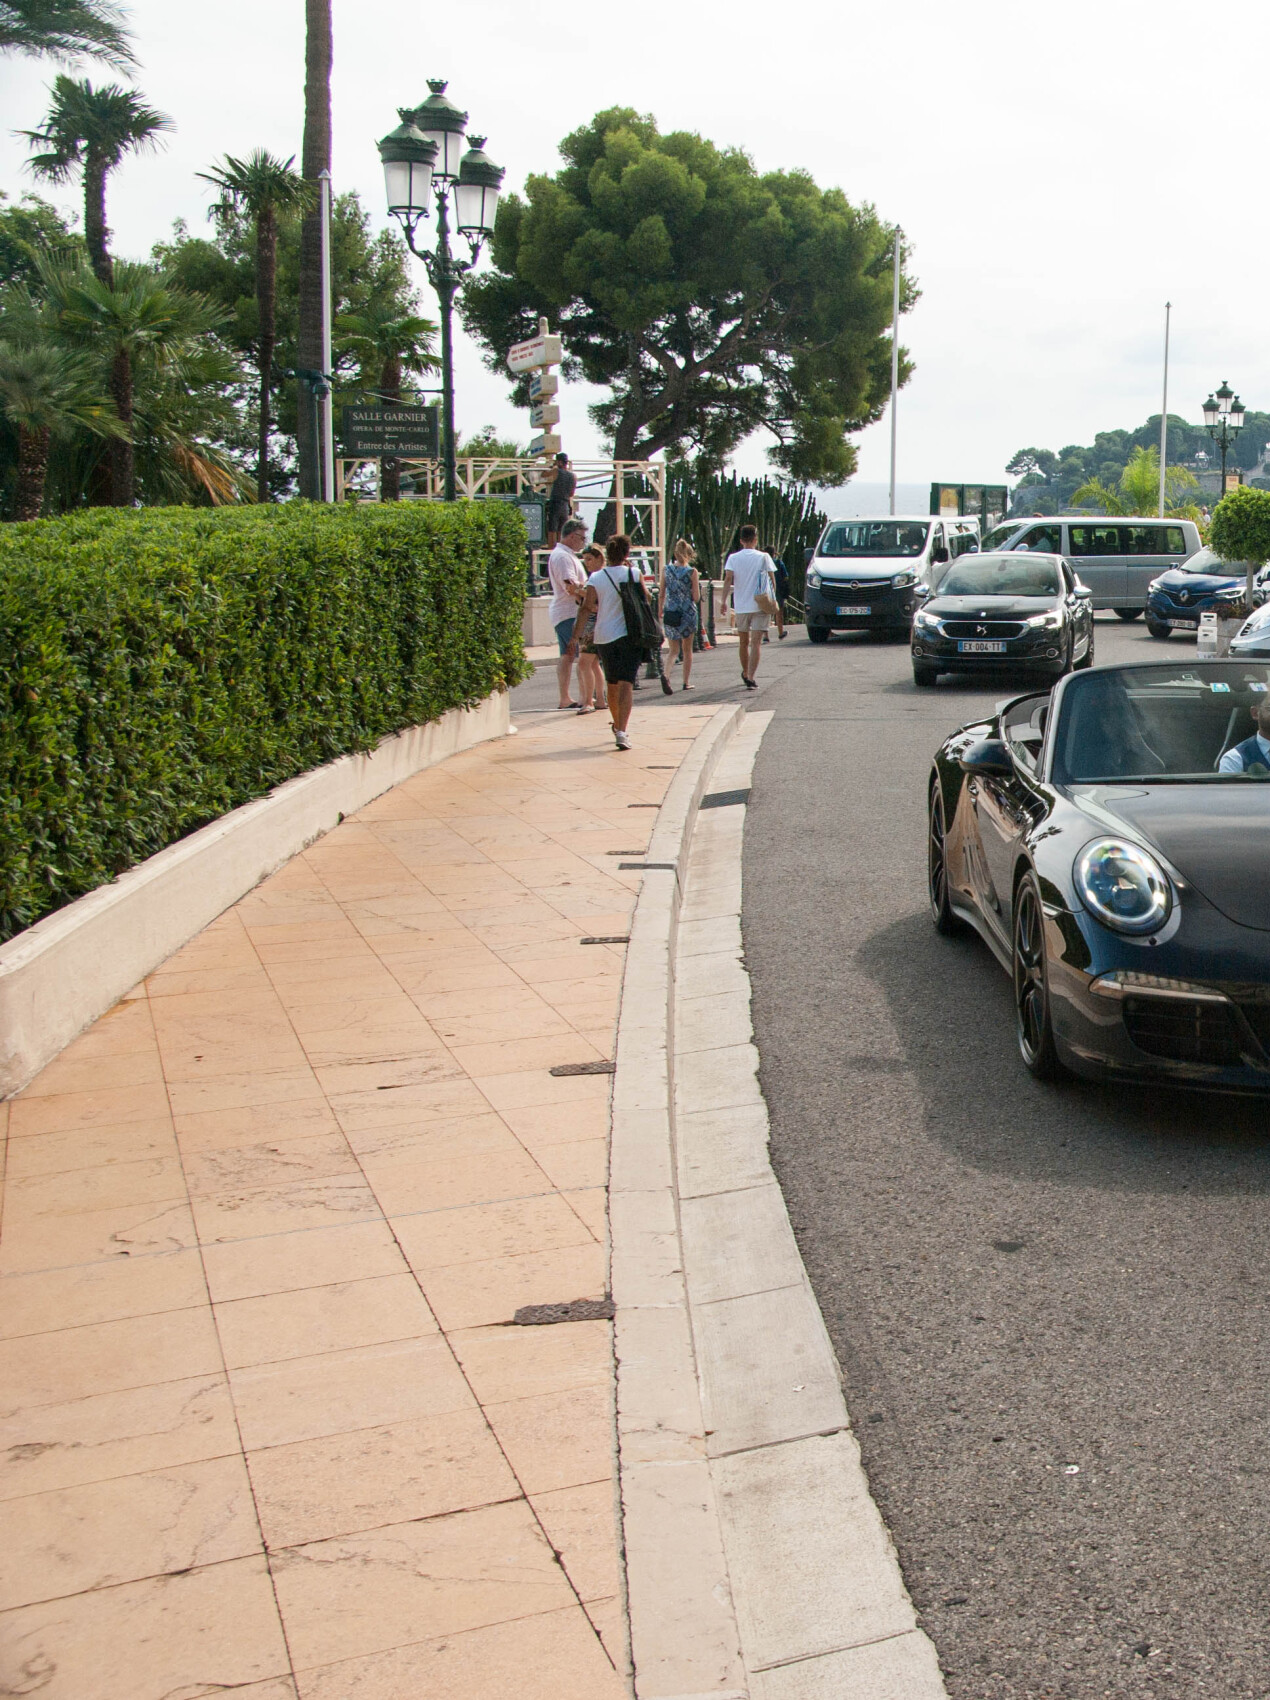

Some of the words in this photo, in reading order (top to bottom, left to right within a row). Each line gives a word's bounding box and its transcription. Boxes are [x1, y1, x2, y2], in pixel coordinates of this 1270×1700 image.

[352, 412, 381, 421] SALLE
[384, 412, 427, 422] GARNIER
[383, 442, 396, 450] des
[398, 442, 428, 451] Artistes
